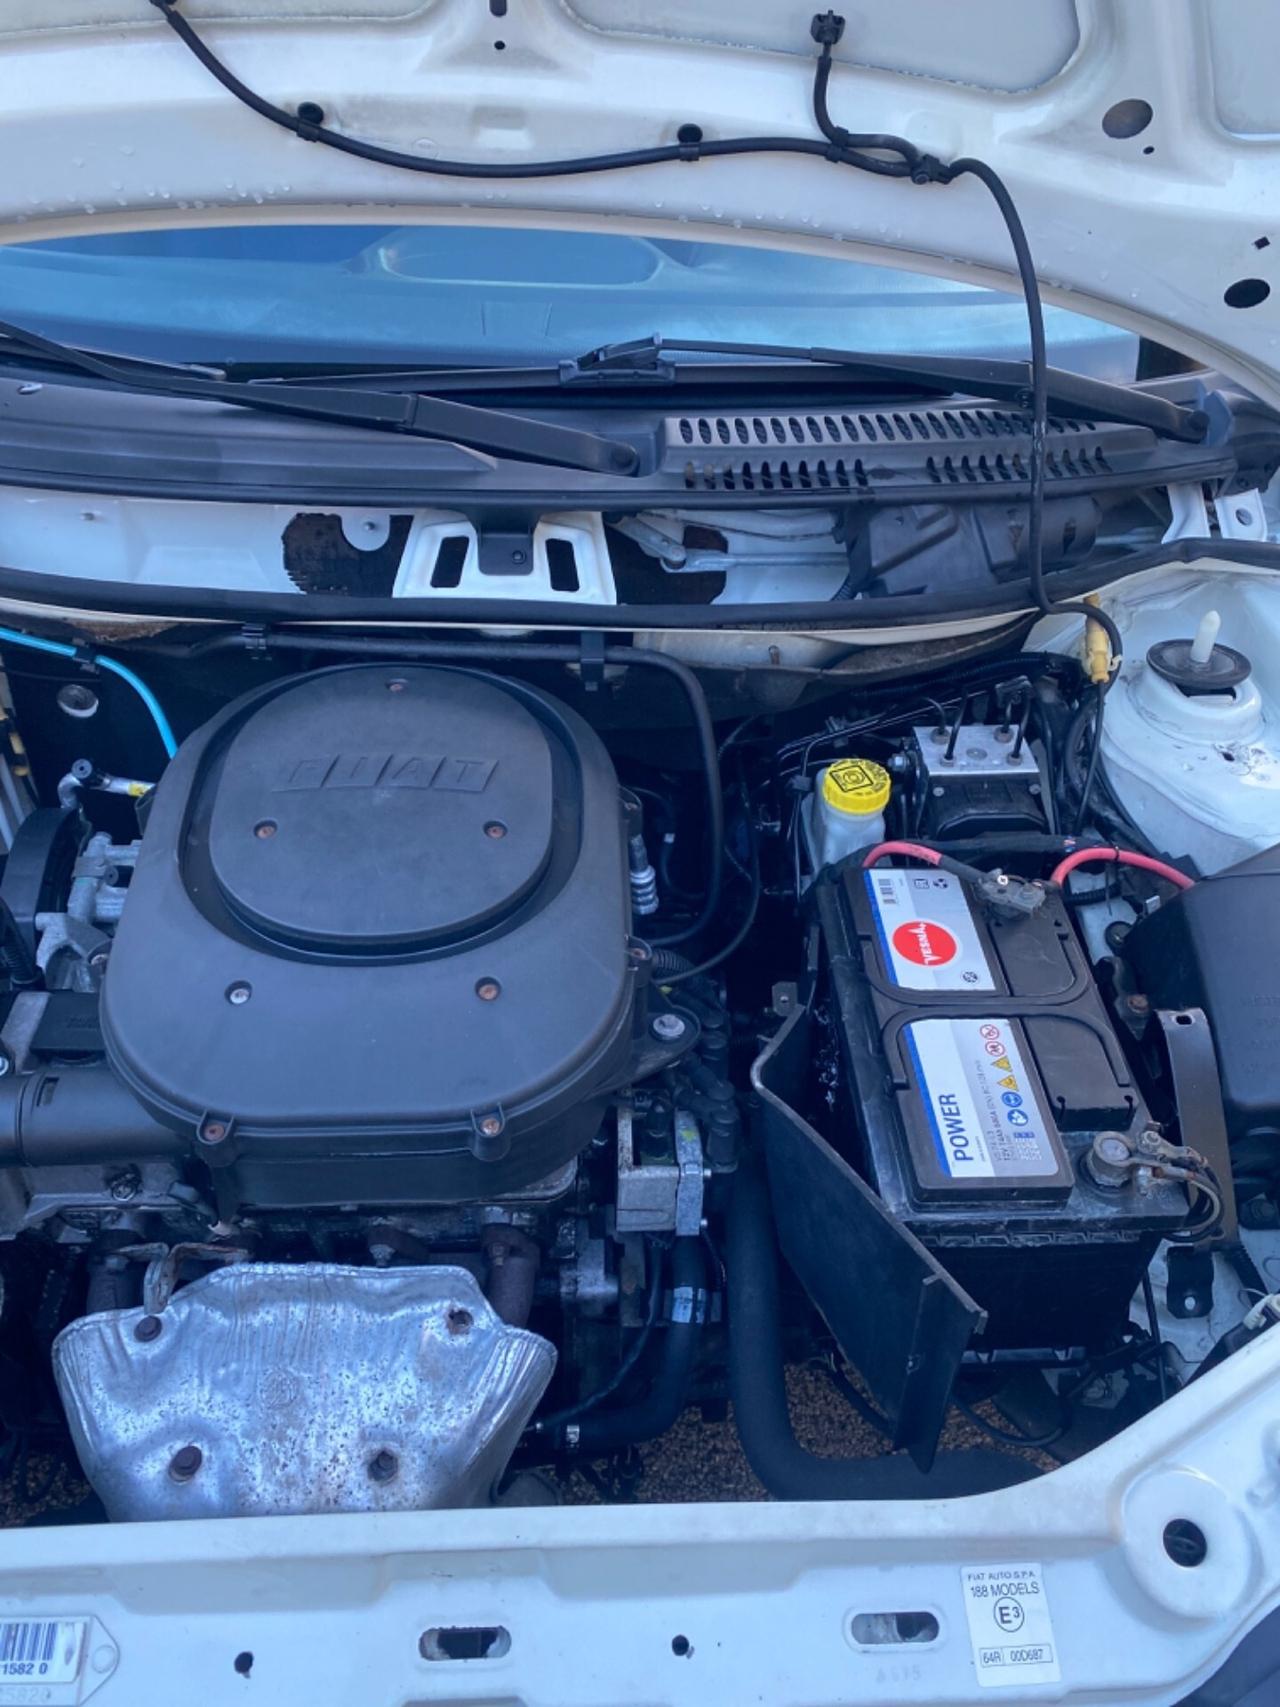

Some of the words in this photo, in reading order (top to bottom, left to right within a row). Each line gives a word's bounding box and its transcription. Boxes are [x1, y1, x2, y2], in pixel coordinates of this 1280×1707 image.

[287, 755, 487, 784] FIAT
[938, 1094, 974, 1160] POWER
[968, 1573, 985, 1581] FIAT
[988, 1571, 1012, 1580] AUTO
[990, 1581, 1040, 1596] MODELS
